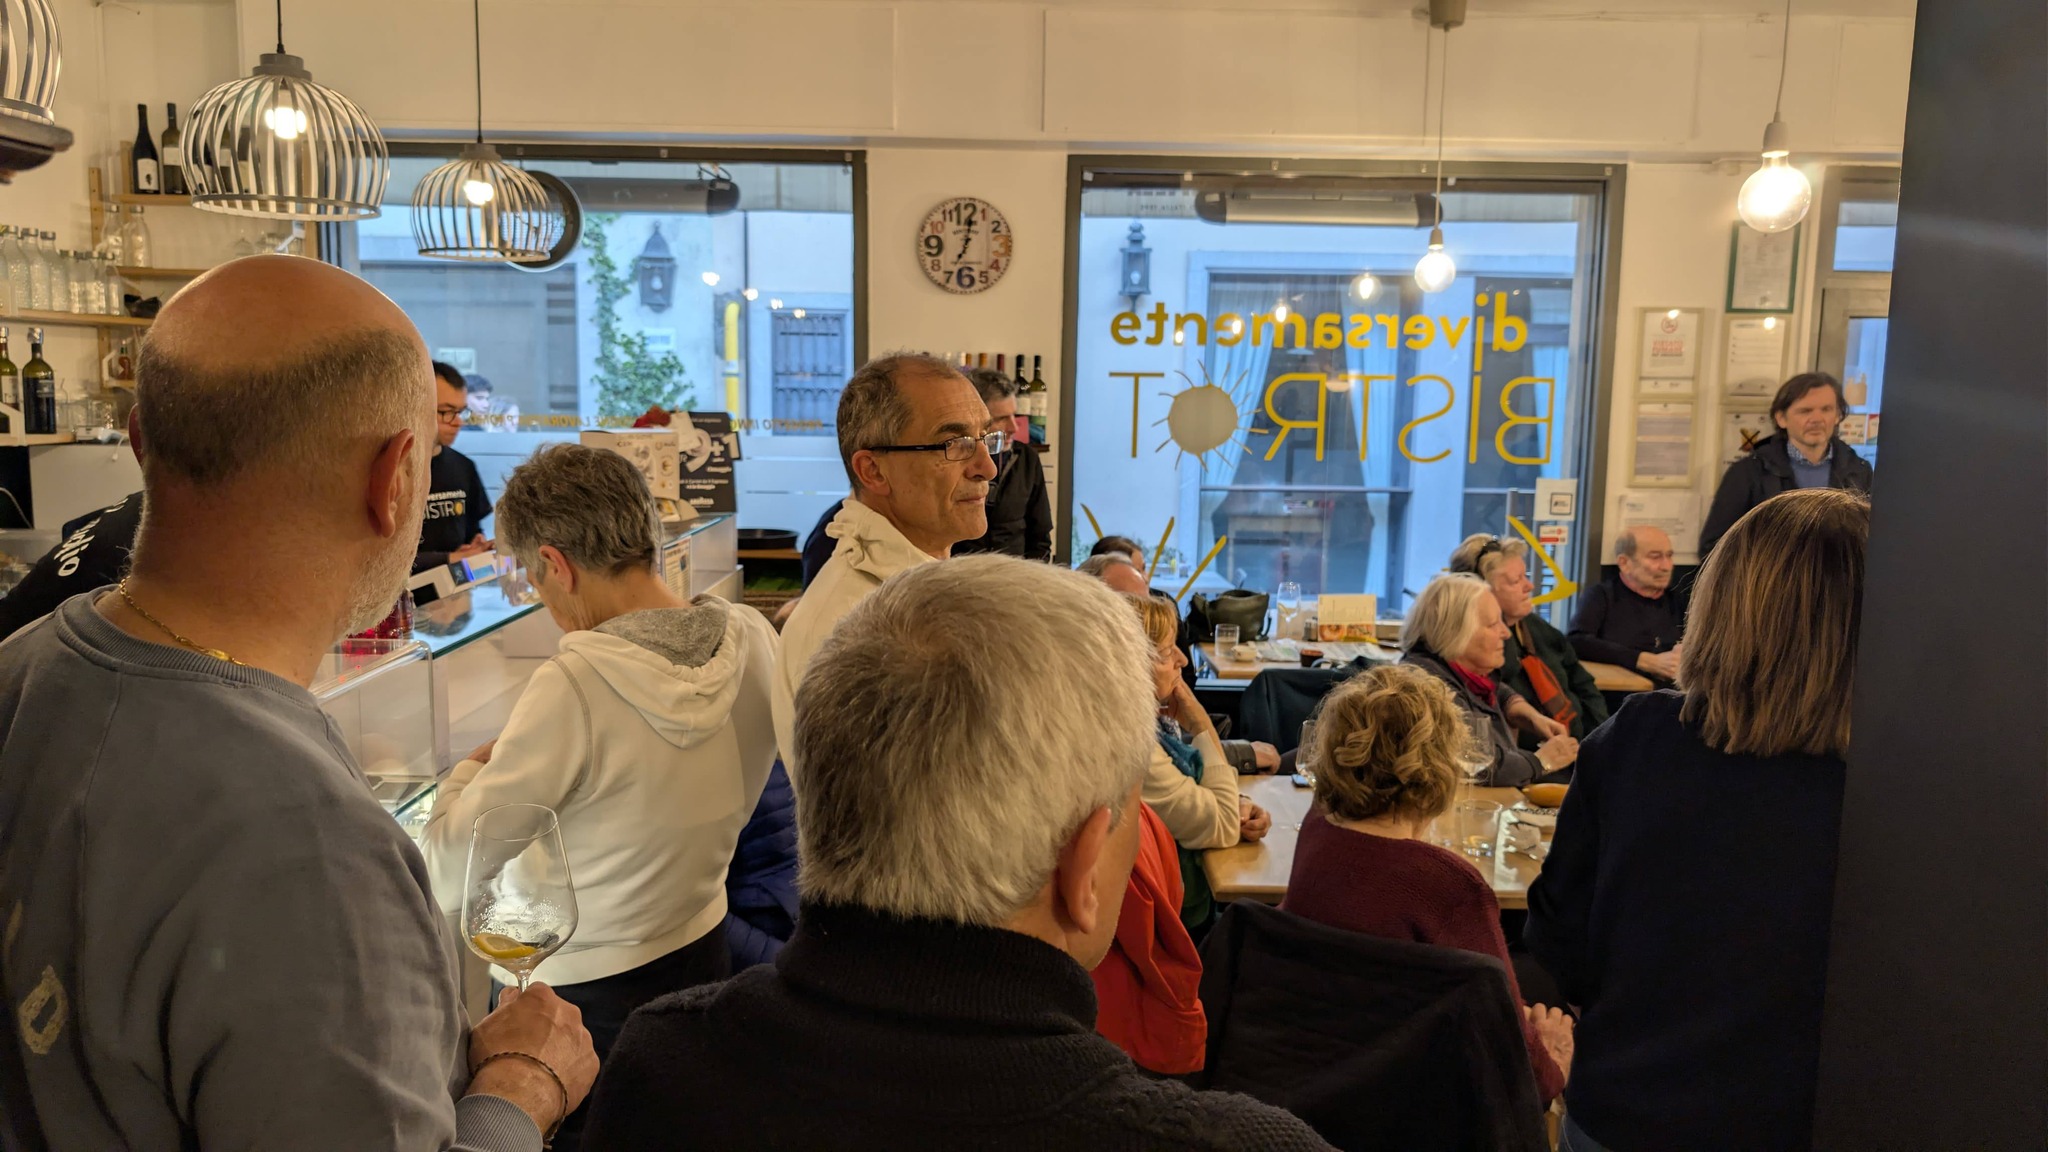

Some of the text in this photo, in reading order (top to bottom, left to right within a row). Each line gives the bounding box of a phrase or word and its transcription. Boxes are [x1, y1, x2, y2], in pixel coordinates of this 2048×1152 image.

[942, 208, 953, 222] 11
[954, 202, 977, 226] 12
[980, 207, 987, 221] 1
[930, 220, 945, 234] 10
[991, 220, 1001, 234] 2
[924, 234, 944, 257] 9
[992, 234, 1011, 258] 3
[930, 259, 941, 272] 8
[990, 259, 1001, 272] 4
[943, 271, 954, 284] 7
[956, 266, 976, 289] 6
[979, 271, 989, 284] 5
